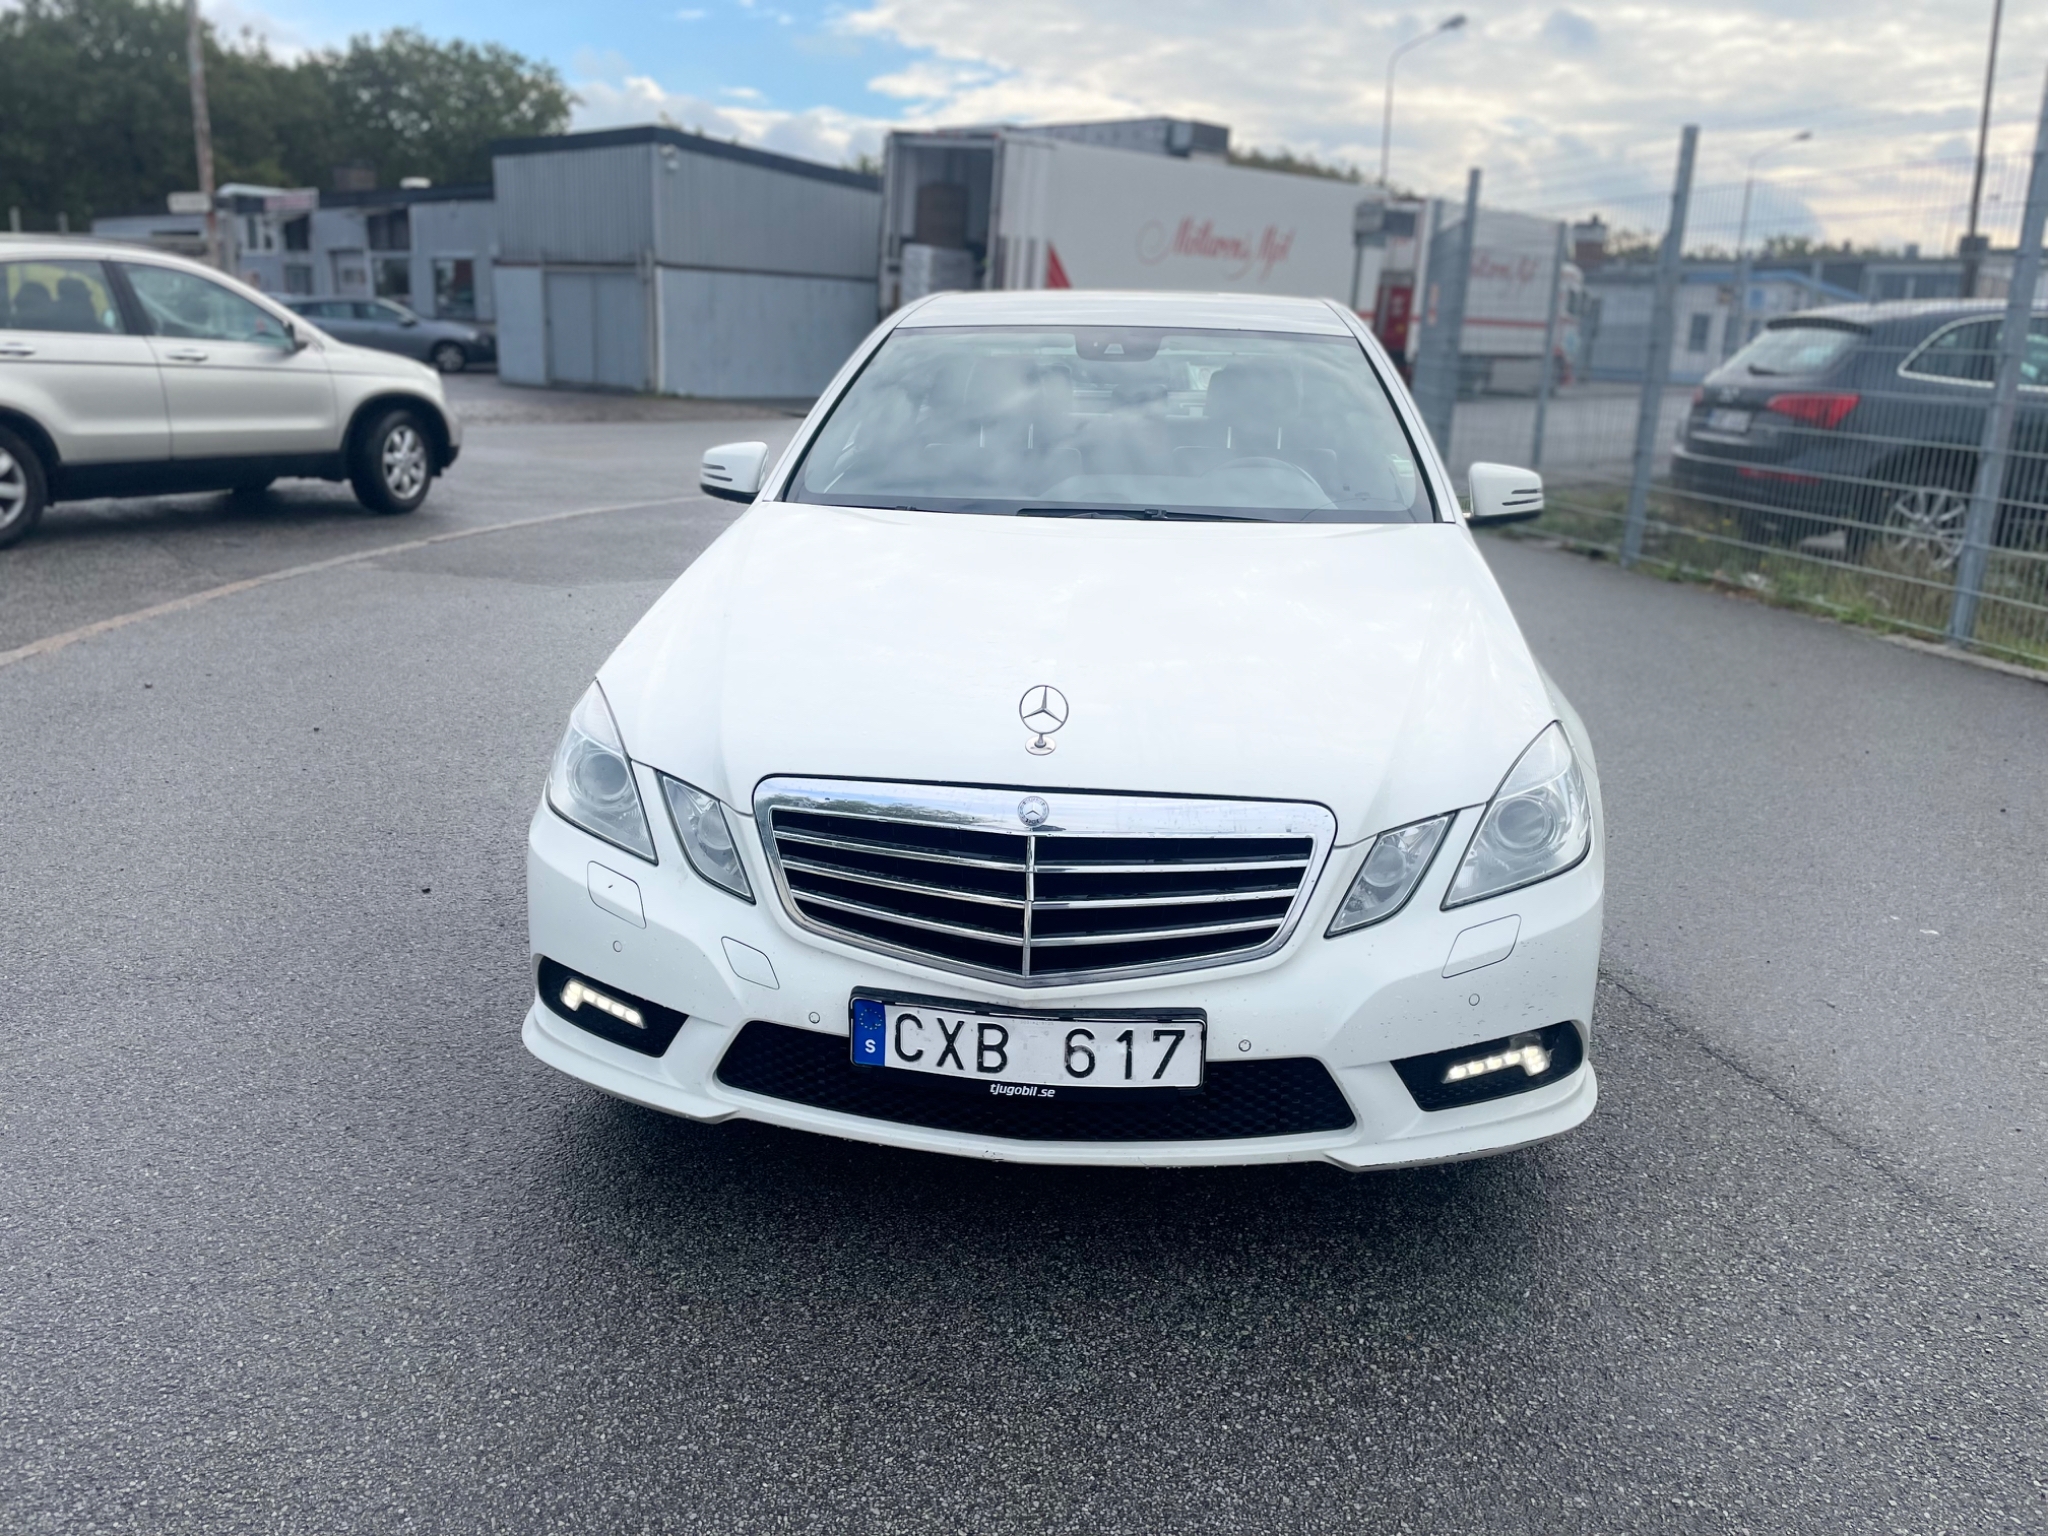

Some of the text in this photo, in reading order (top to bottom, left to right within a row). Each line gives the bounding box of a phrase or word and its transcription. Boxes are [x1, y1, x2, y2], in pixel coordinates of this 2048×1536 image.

[864, 1039, 877, 1054] S
[894, 1012, 1186, 1080] CXB 617
[989, 1083, 1056, 1097] tjugobil.se
